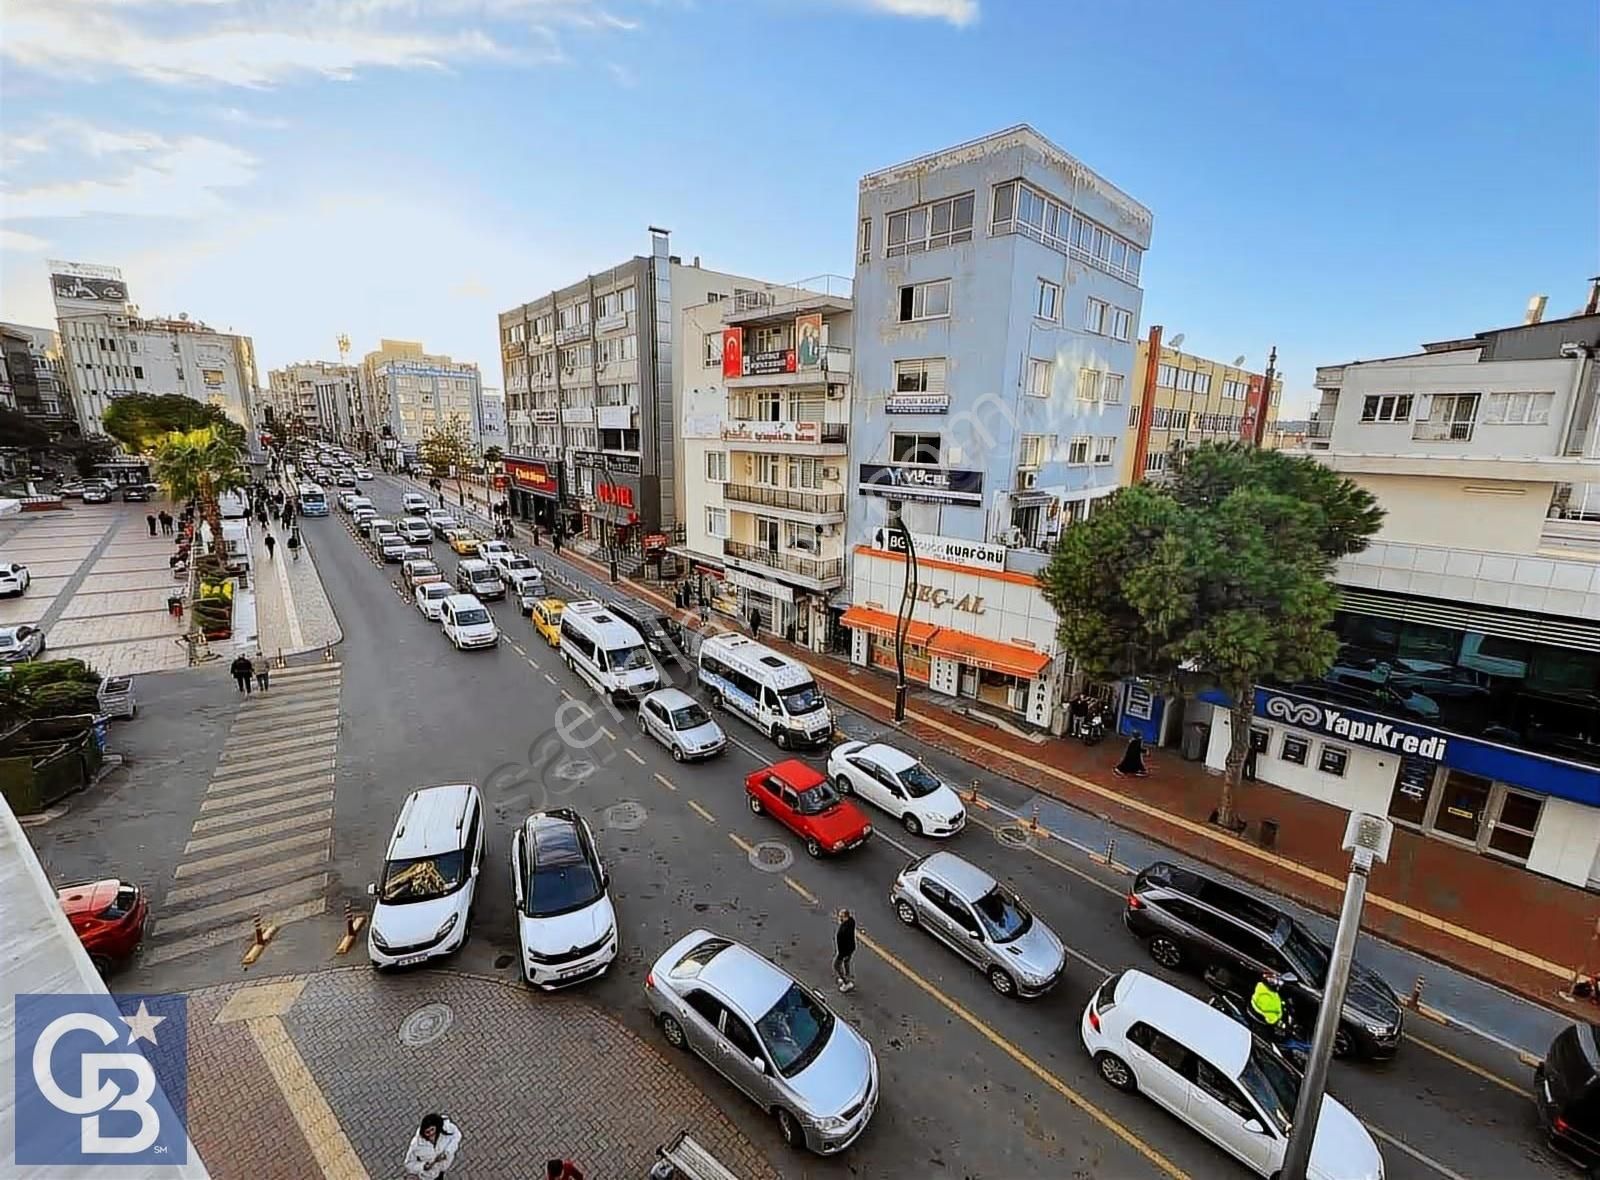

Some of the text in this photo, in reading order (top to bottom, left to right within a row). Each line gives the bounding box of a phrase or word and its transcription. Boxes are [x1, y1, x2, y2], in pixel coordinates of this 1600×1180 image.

[905, 469, 950, 486] YÜCEL
[945, 544, 1003, 564] KUAFÖRÜ
[1323, 708, 1447, 761] YapıKredi
